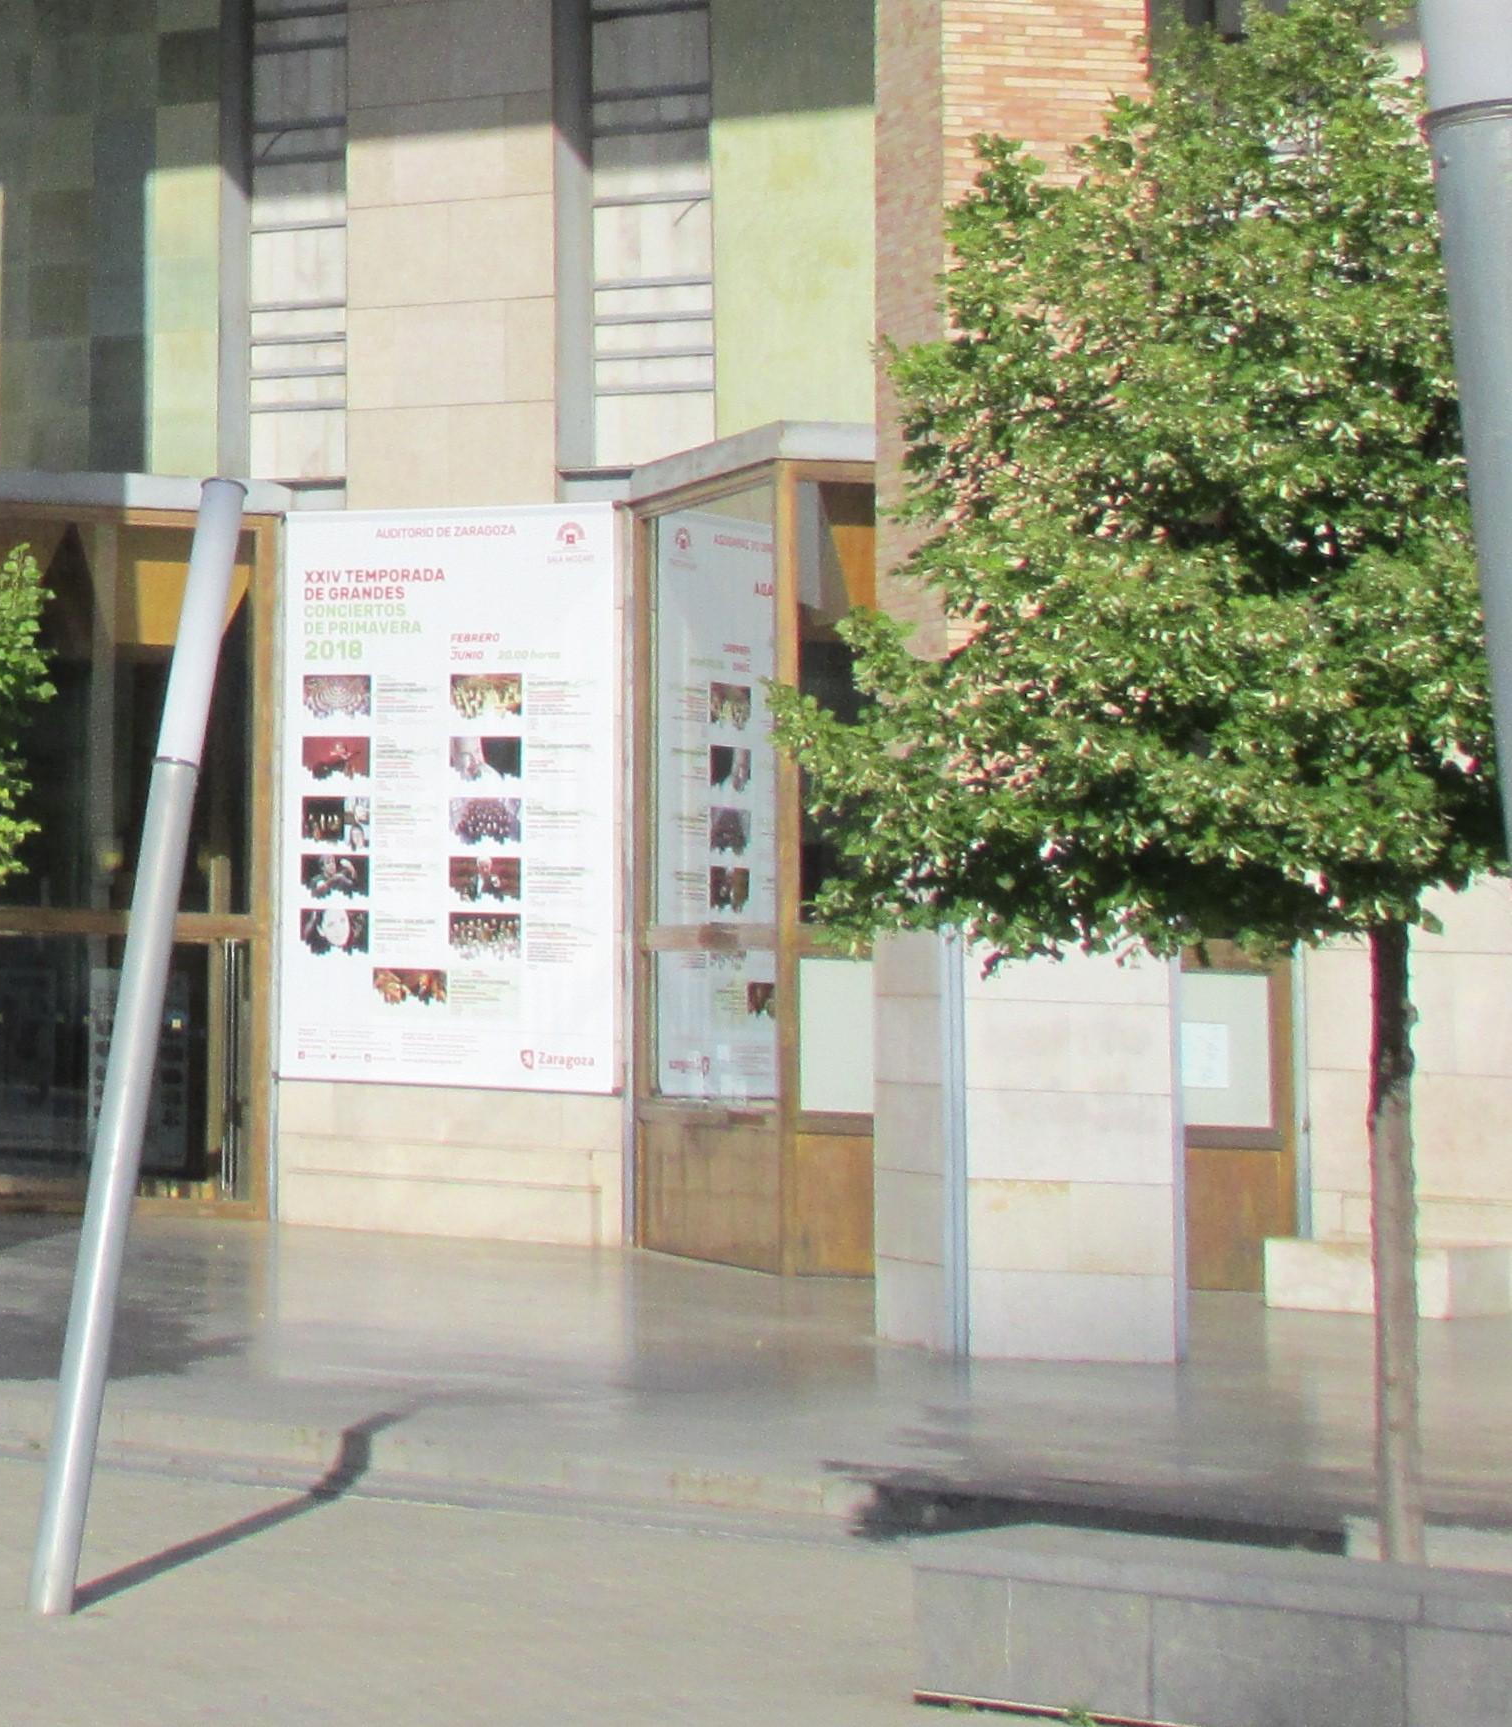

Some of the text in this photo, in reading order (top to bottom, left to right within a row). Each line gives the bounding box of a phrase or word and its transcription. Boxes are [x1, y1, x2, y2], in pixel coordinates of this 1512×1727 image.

[375, 524, 516, 539] AUDITORIO DE ZARAGOZA
[304, 568, 445, 584] XXIV TEMPORADA
[304, 586, 405, 601] DE GRANDES
[304, 603, 406, 618] CONCIERTOS
[304, 620, 423, 635] DE PRIMAVERA
[450, 632, 500, 643] FEBRERO
[304, 639, 363, 660] 2018
[450, 650, 484, 660] JUNIO
[538, 1051, 595, 1070] Zaragoza
